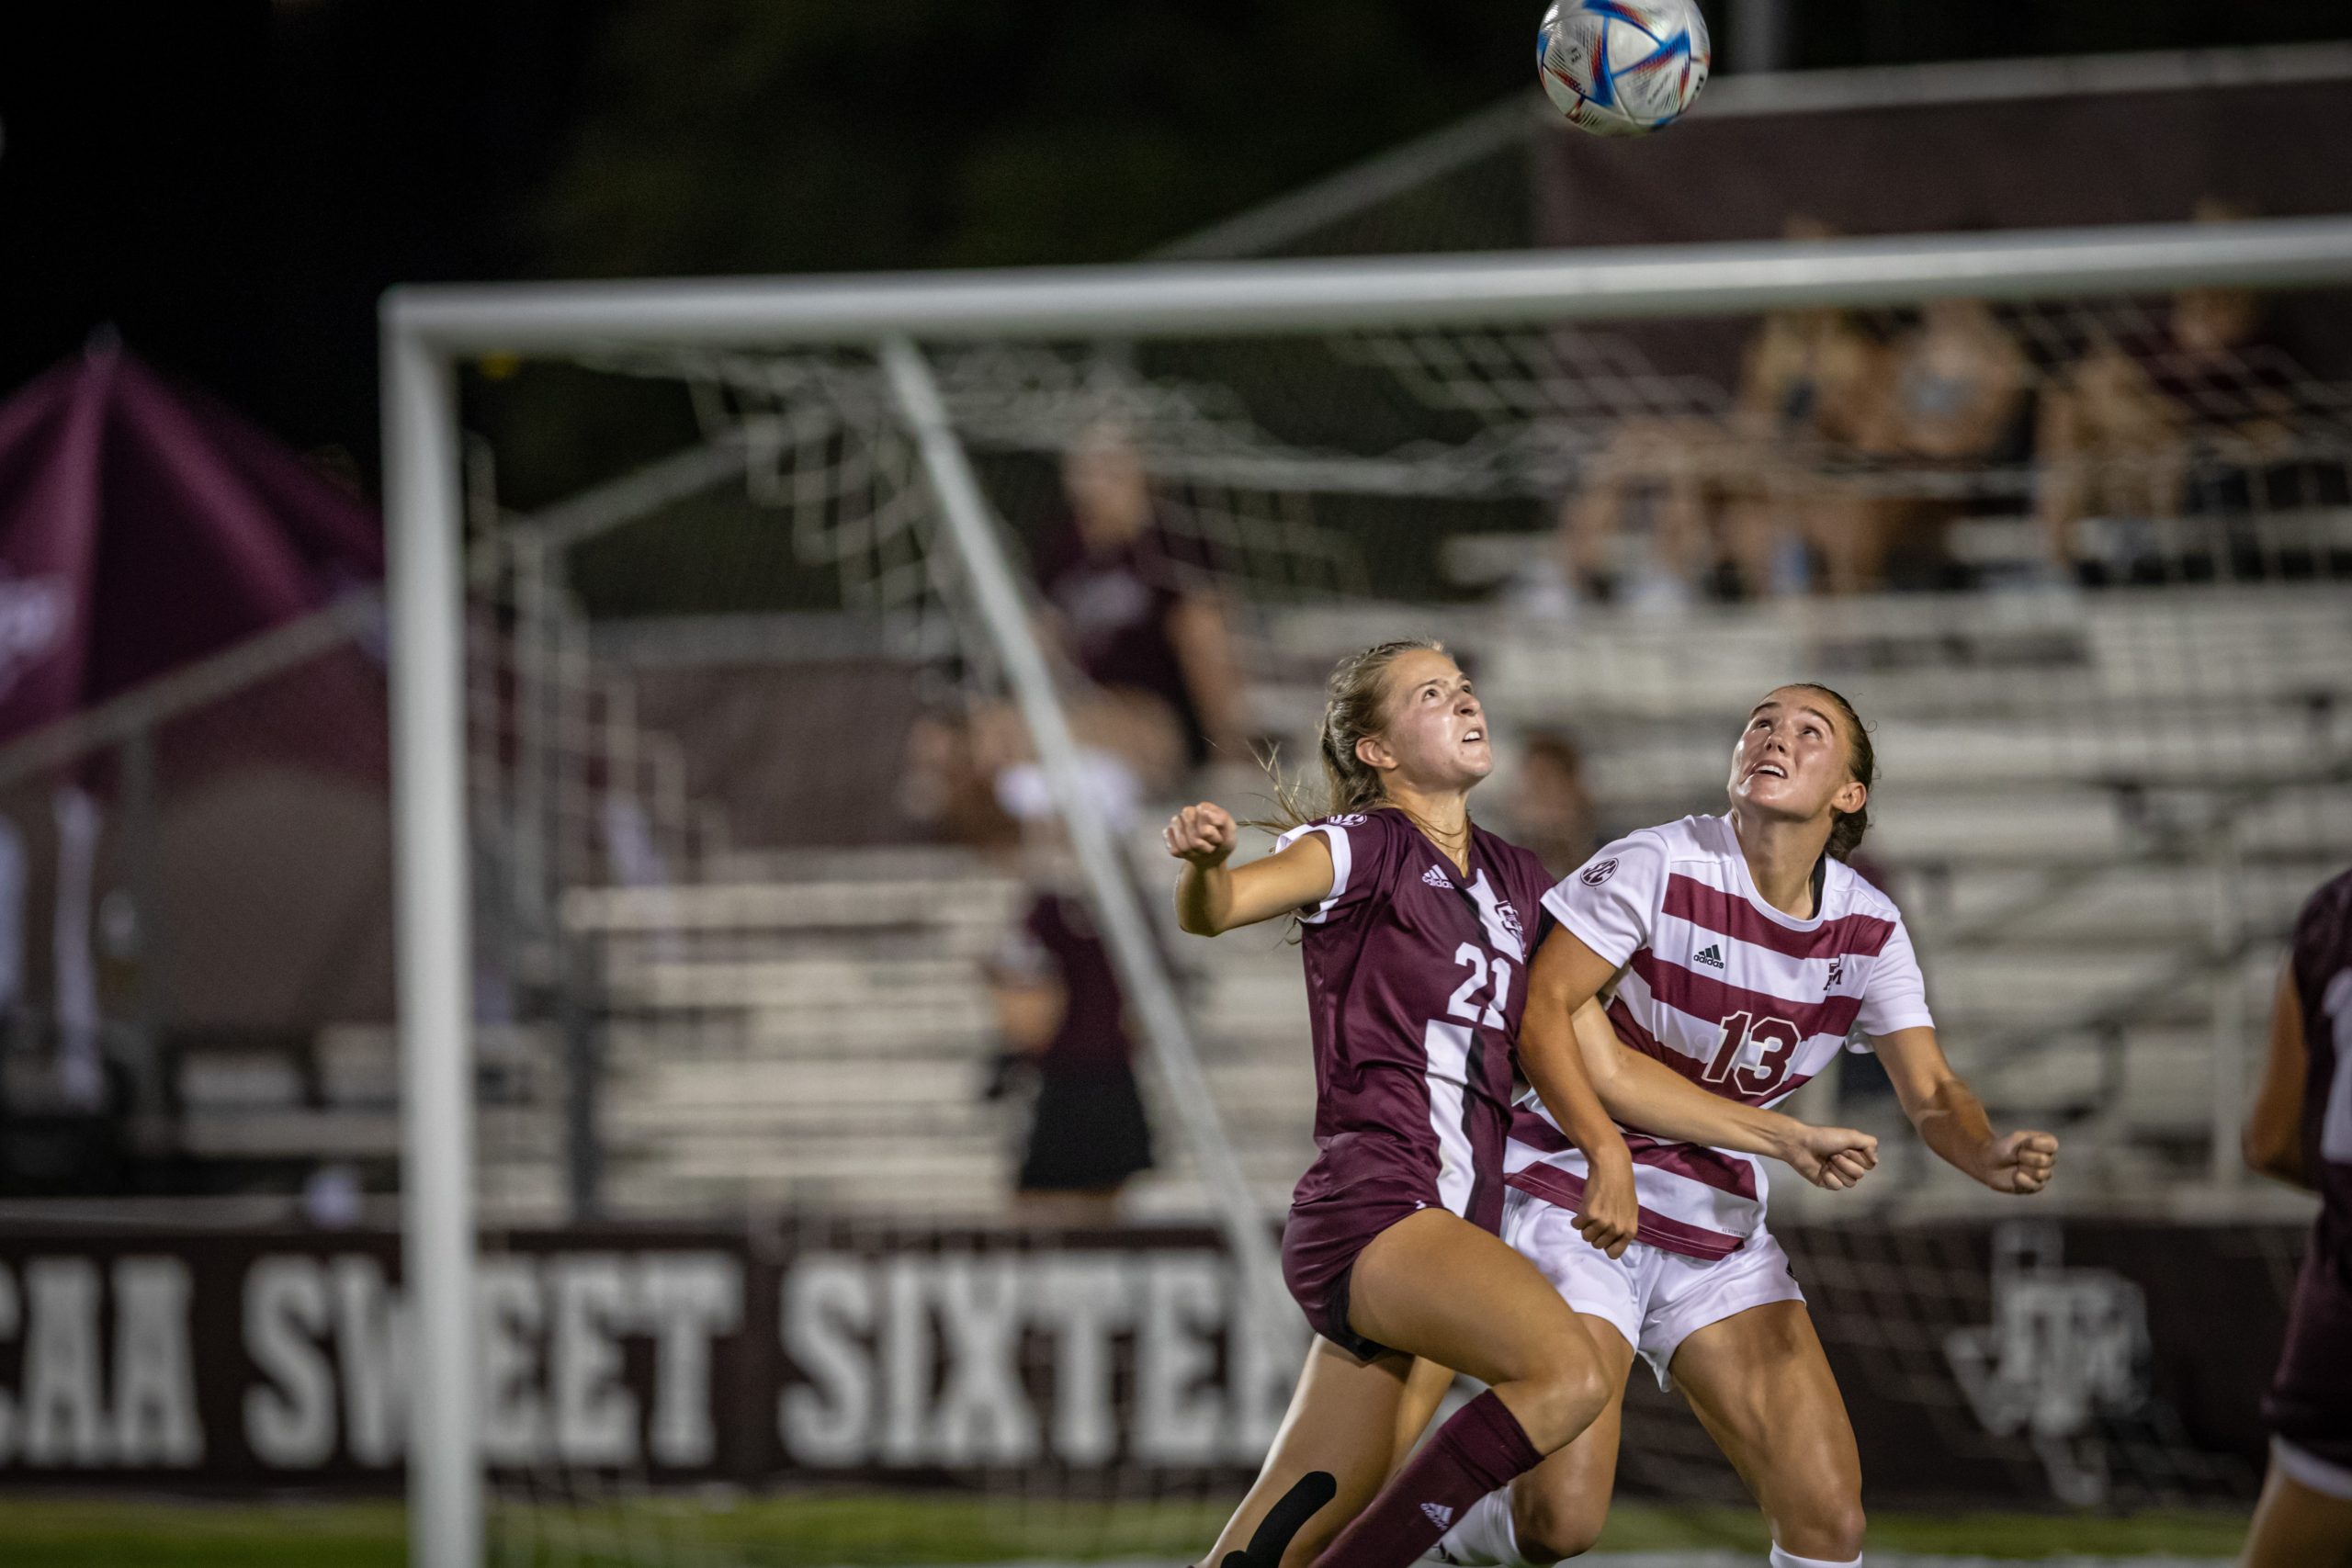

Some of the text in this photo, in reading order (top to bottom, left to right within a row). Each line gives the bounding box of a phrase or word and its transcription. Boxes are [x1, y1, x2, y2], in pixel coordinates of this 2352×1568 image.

[1447, 942, 1512, 1031] 21
[1693, 953, 1724, 969] adidas
[1702, 1010, 1802, 1096] 13
[0, 1254, 206, 1465] AA
